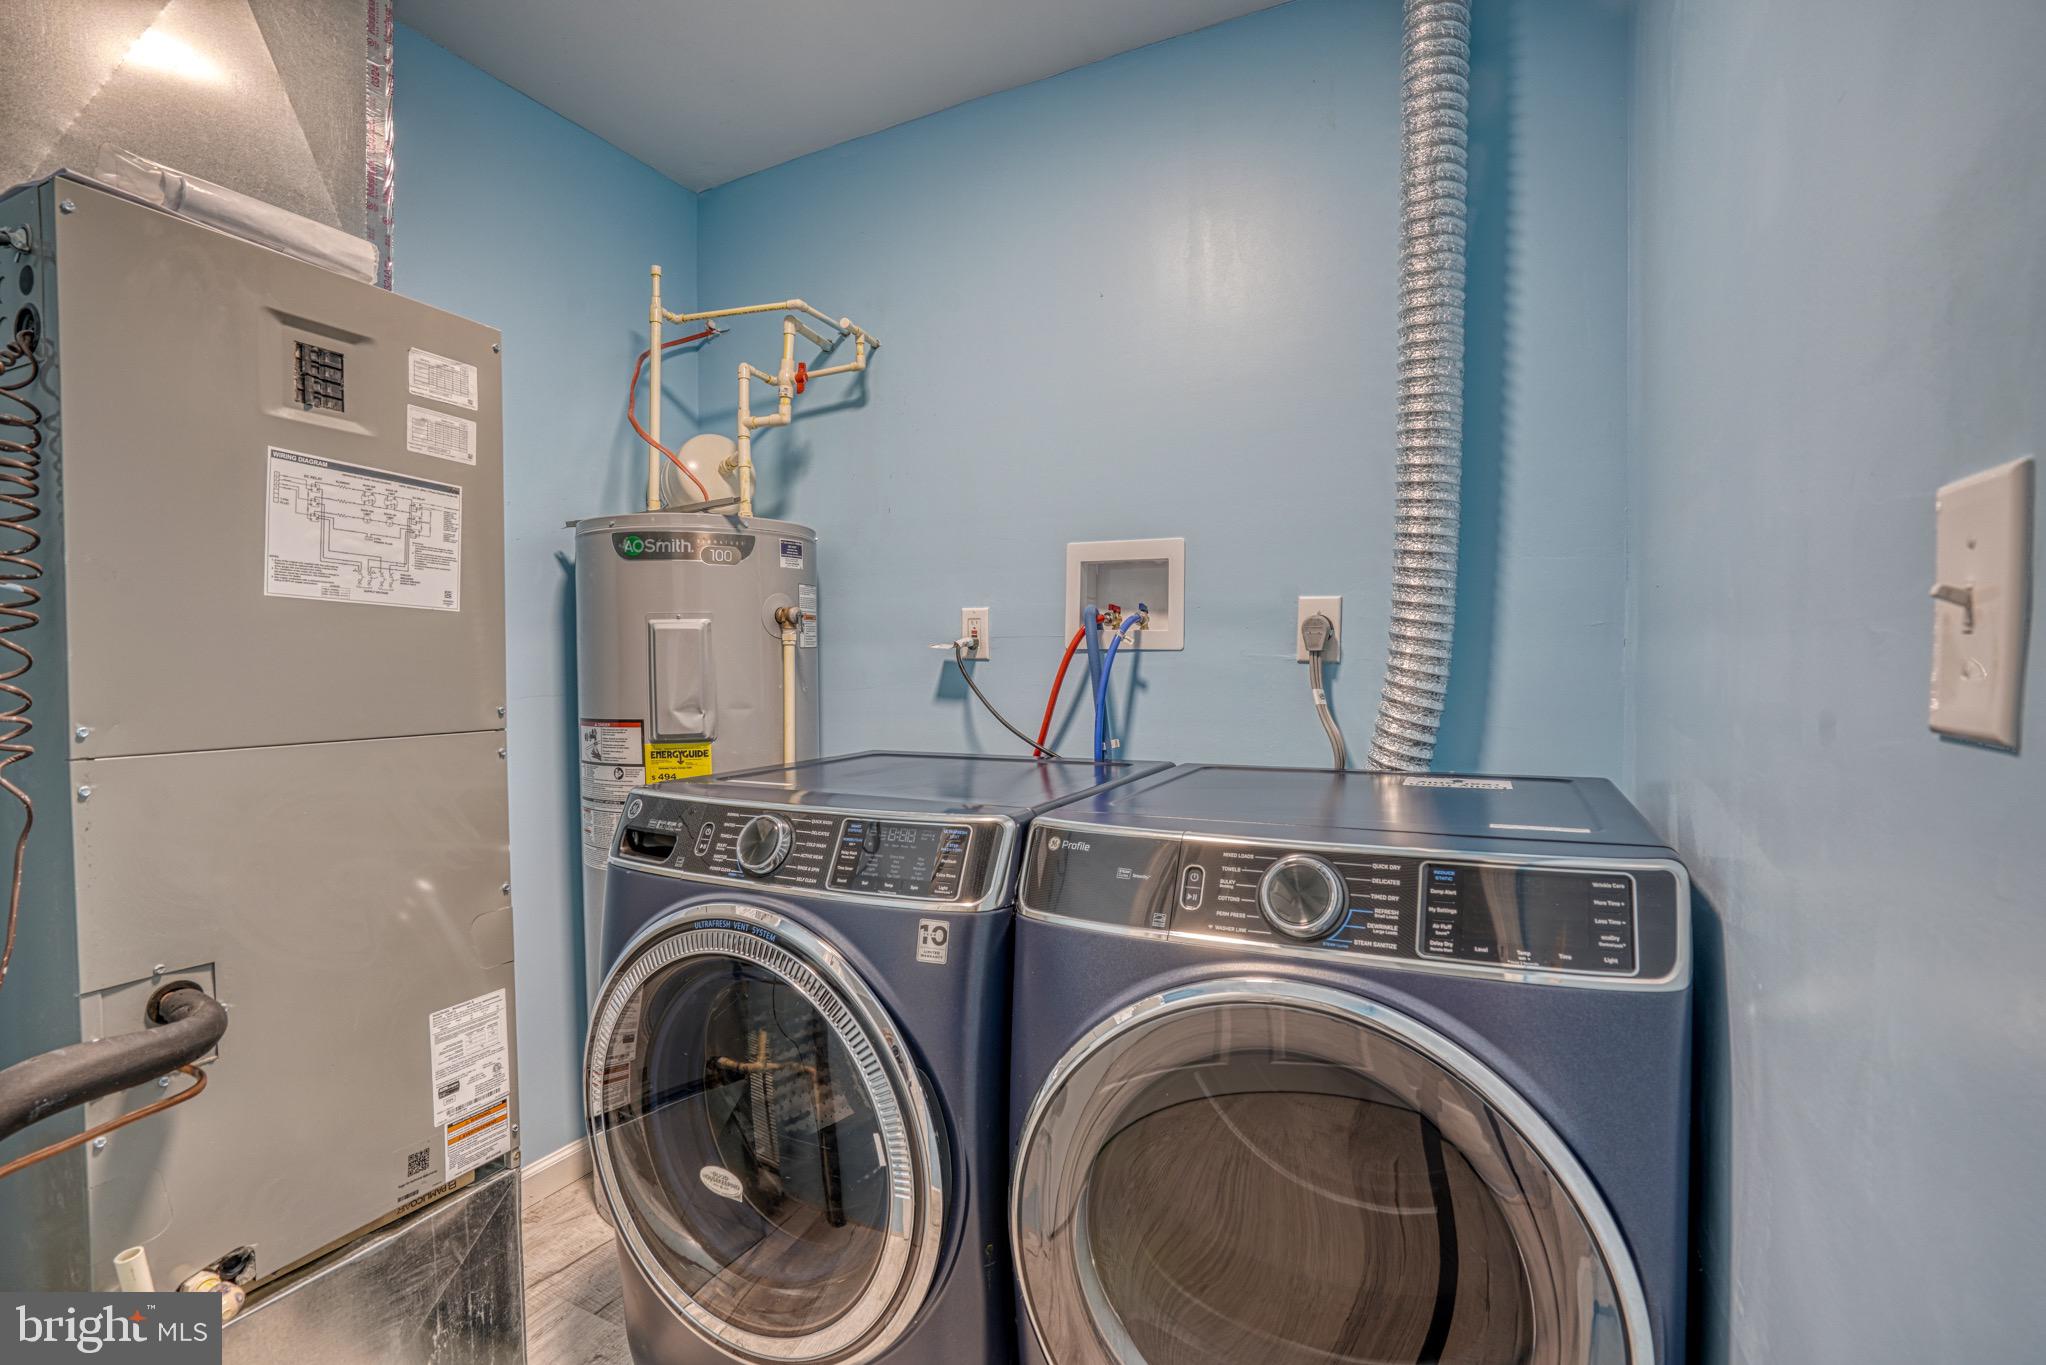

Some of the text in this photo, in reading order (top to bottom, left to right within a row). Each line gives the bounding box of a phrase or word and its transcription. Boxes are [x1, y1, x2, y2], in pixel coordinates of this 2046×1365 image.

[272, 451, 328, 468] WIRING DIAGRAM
[710, 549, 732, 562] 100
[1062, 840, 1090, 852] Profile
[1372, 878, 1400, 886] DELICATES
[1374, 908, 1400, 916] REFRESH
[694, 920, 776, 942] ULTRAFRESH VENT SYSTEM
[1366, 923, 1398, 931] DEWRINKLE
[920, 924, 948, 946] 10
[1372, 941, 1398, 950] SANITIZE
